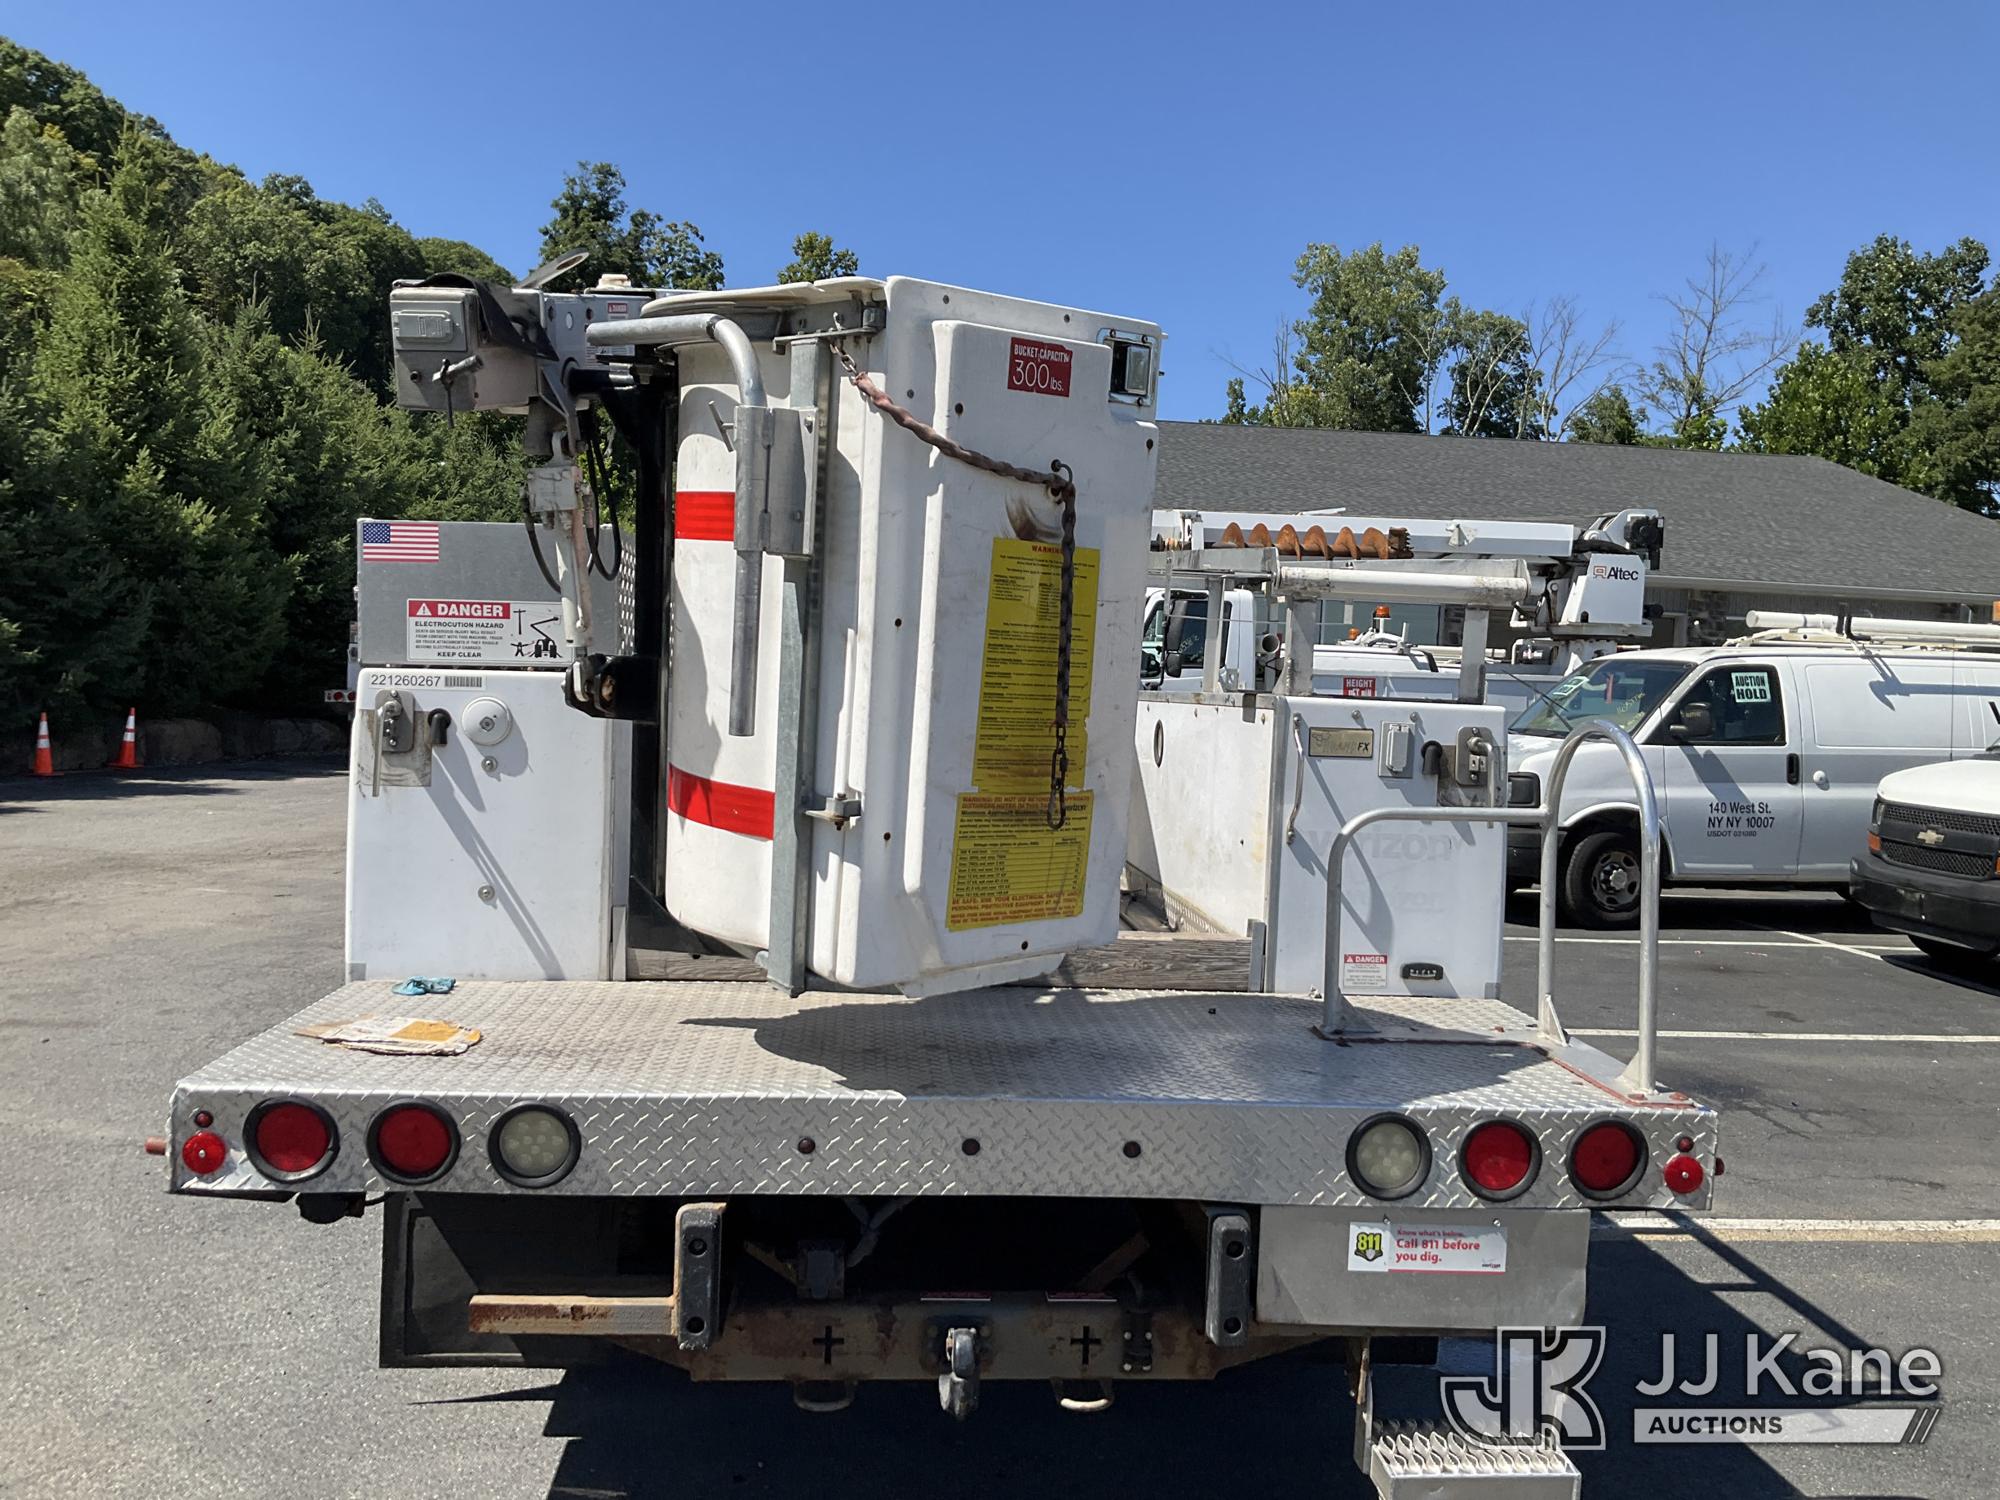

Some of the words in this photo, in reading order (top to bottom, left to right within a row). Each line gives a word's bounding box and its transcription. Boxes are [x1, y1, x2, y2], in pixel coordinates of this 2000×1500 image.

[1014, 344, 1038, 358] BUCKET
[1040, 348, 1070, 362] CAPACITY
[1012, 360, 1050, 388] 300
[1050, 376, 1064, 392] lbs.
[1032, 545, 1063, 554] WARNIN
[1607, 566, 1638, 580] Altec
[438, 604, 503, 617] DANGER
[371, 674, 440, 687] 221260267
[1346, 678, 1374, 688] HEIGHT
[1734, 676, 1766, 687] AUCTION
[1736, 688, 1768, 700] HOLD
[1358, 742, 1370, 752] FX
[1709, 802, 1727, 814] 140
[1730, 801, 1755, 814] West
[1758, 802, 1771, 814] St.
[1708, 816, 1723, 828] NY
[1726, 816, 1742, 828] NY
[1746, 816, 1775, 828] 10007
[1356, 1232, 1382, 1250] 811
[1396, 1238, 1418, 1248] Call
[1421, 1239, 1439, 1249] 811
[1442, 1239, 1480, 1250] before
[1396, 1252, 1417, 1263] you
[1420, 1251, 1442, 1264] dig.
